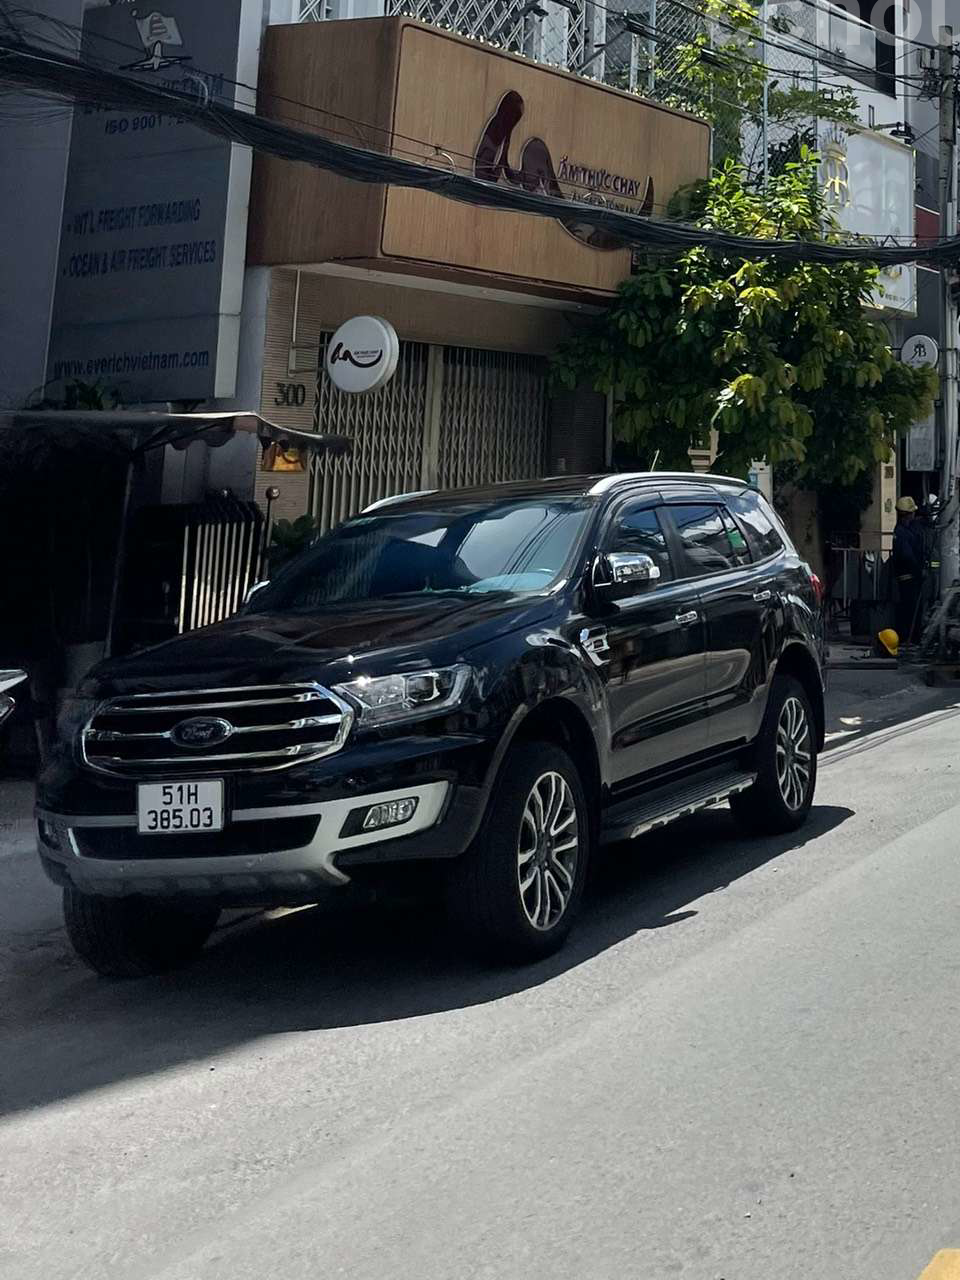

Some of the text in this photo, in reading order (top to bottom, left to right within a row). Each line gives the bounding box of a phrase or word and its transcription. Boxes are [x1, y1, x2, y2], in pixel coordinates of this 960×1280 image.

[612, 176, 641, 197] CHAY
[127, 245, 168, 271] FREIGHT
[168, 239, 217, 268] SERVICES
[53, 349, 210, 378] www.everichvietnam.com
[274, 382, 306, 407] 300
[162, 784, 199, 805] 51H
[147, 807, 214, 830] 385.03
